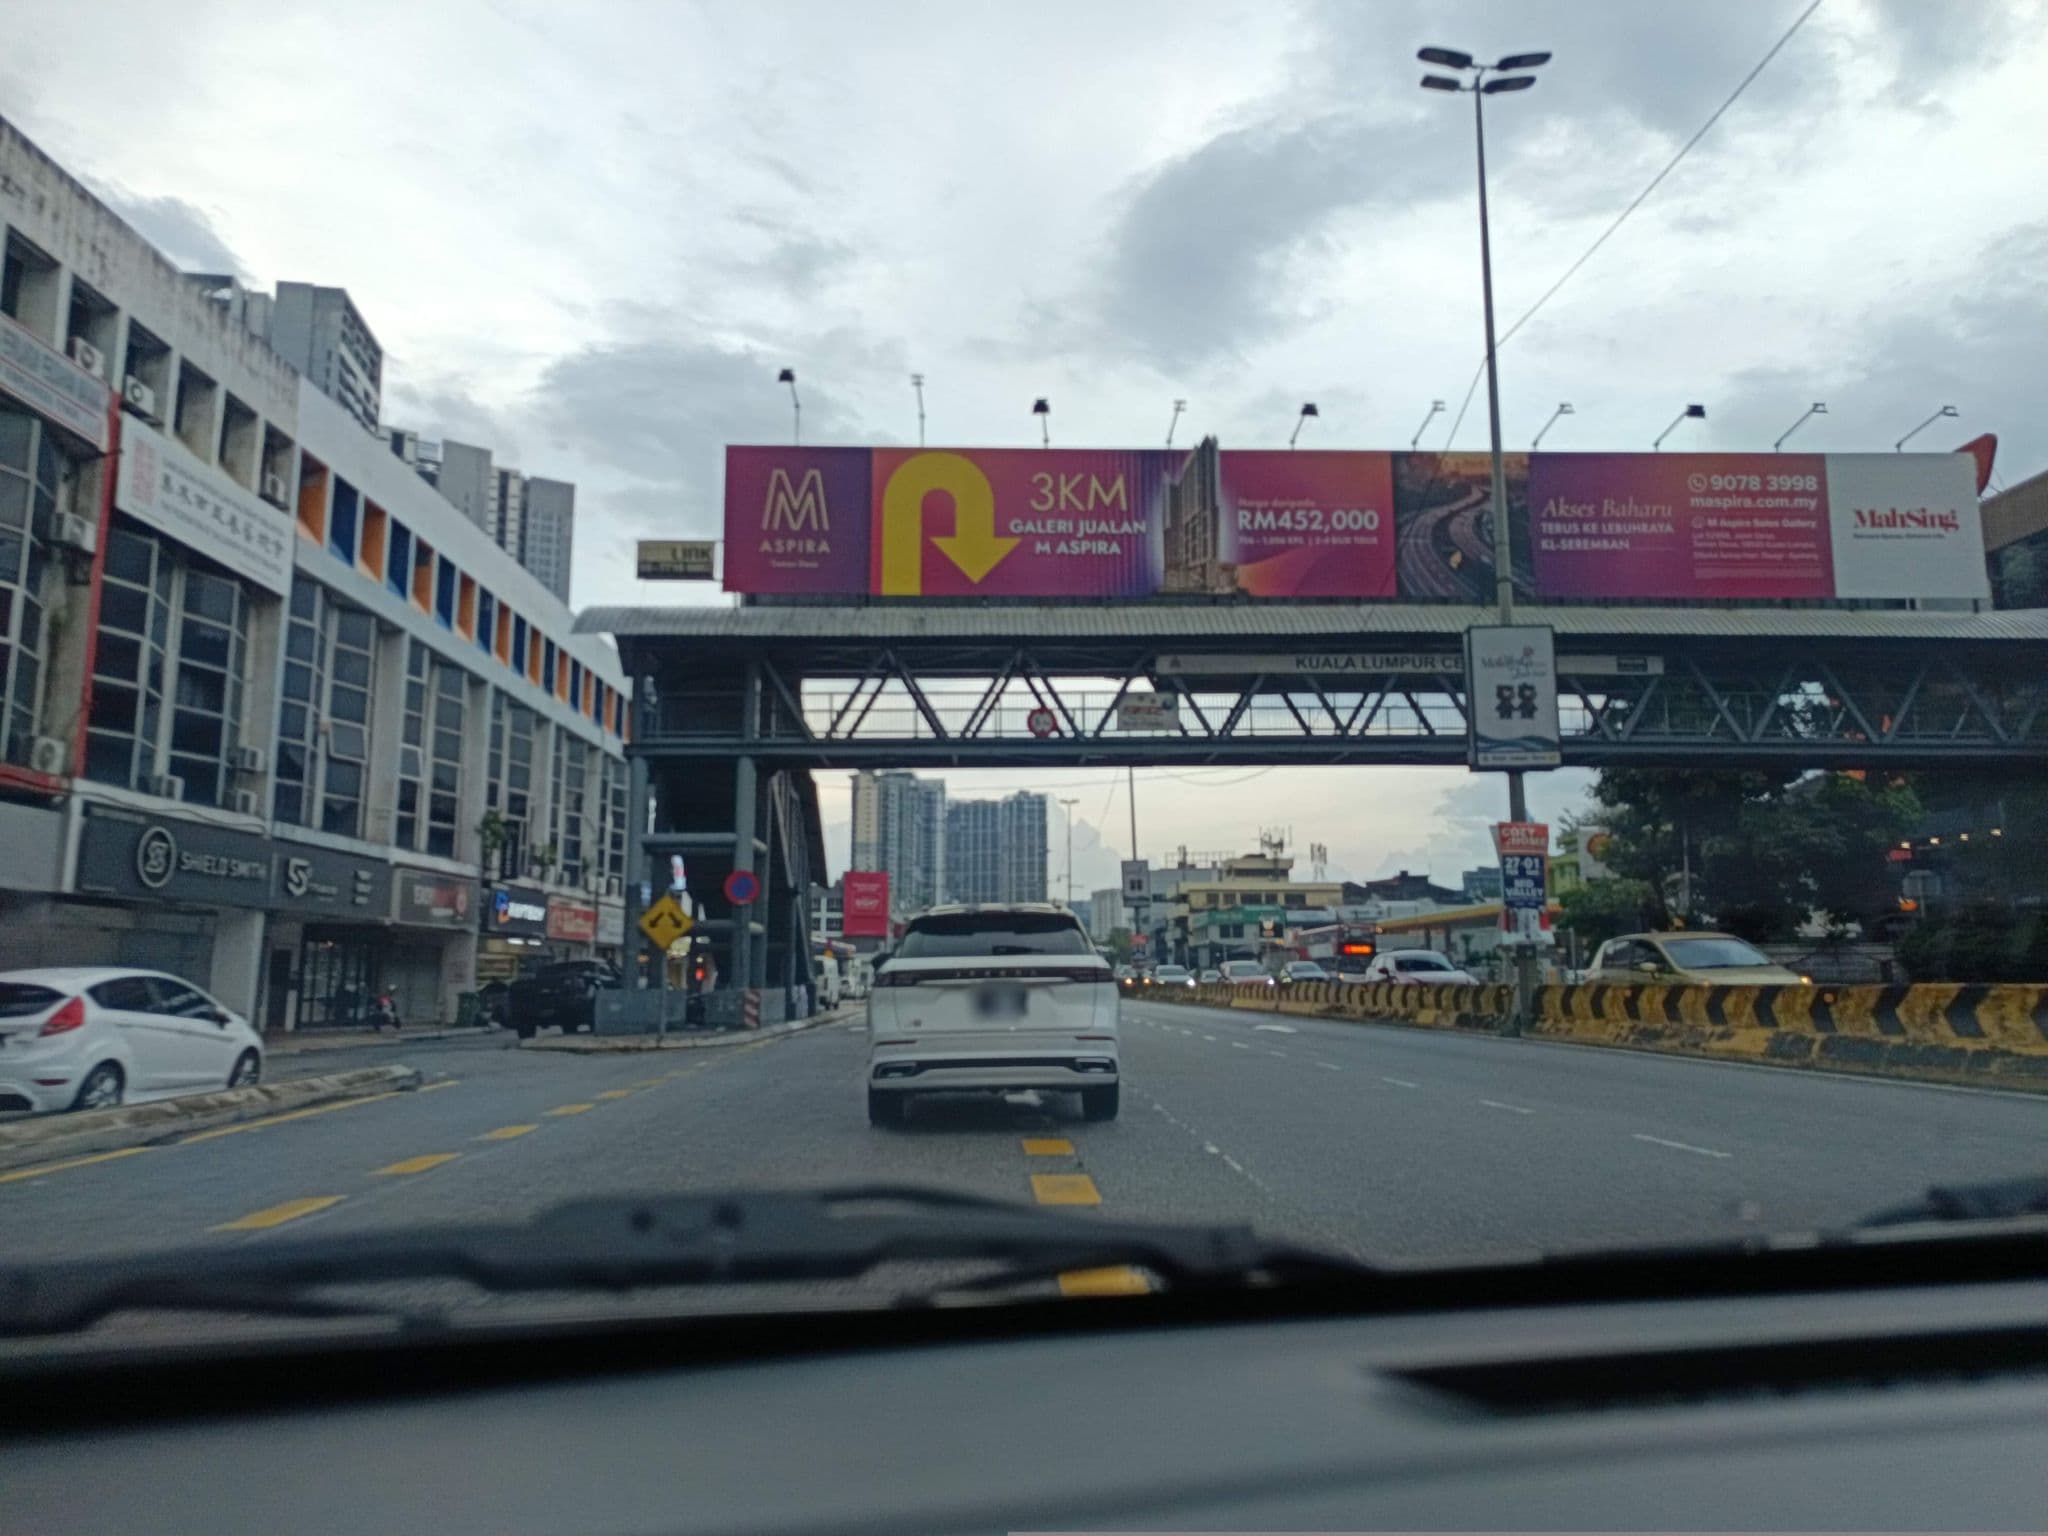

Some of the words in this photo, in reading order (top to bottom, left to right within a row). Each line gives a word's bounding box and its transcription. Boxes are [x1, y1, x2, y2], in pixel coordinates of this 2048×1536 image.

[1710, 475, 1761, 491] 9078
[1766, 475, 1818, 491] 3998
[1030, 472, 1128, 511] 3KM
[1541, 496, 1595, 517] Akses
[1602, 496, 1673, 517] Baharu
[1690, 494, 1818, 511] maspira.com.my
[1009, 519, 1073, 534] GALERI
[1076, 519, 1146, 538] JUALAN
[1238, 509, 1379, 533] RM452,000
[1541, 522, 1580, 534] TERUS
[1582, 522, 1600, 534] KE
[1602, 522, 1674, 534] LEBUHRAYA
[758, 538, 831, 553] ASPIRA
[1035, 541, 1051, 554] M
[1057, 541, 1121, 555] ASPIRA
[1541, 538, 1630, 550] KL-SEREMBAN
[1296, 655, 1356, 670] KUALA
[1361, 655, 1436, 670] LUMPUR
